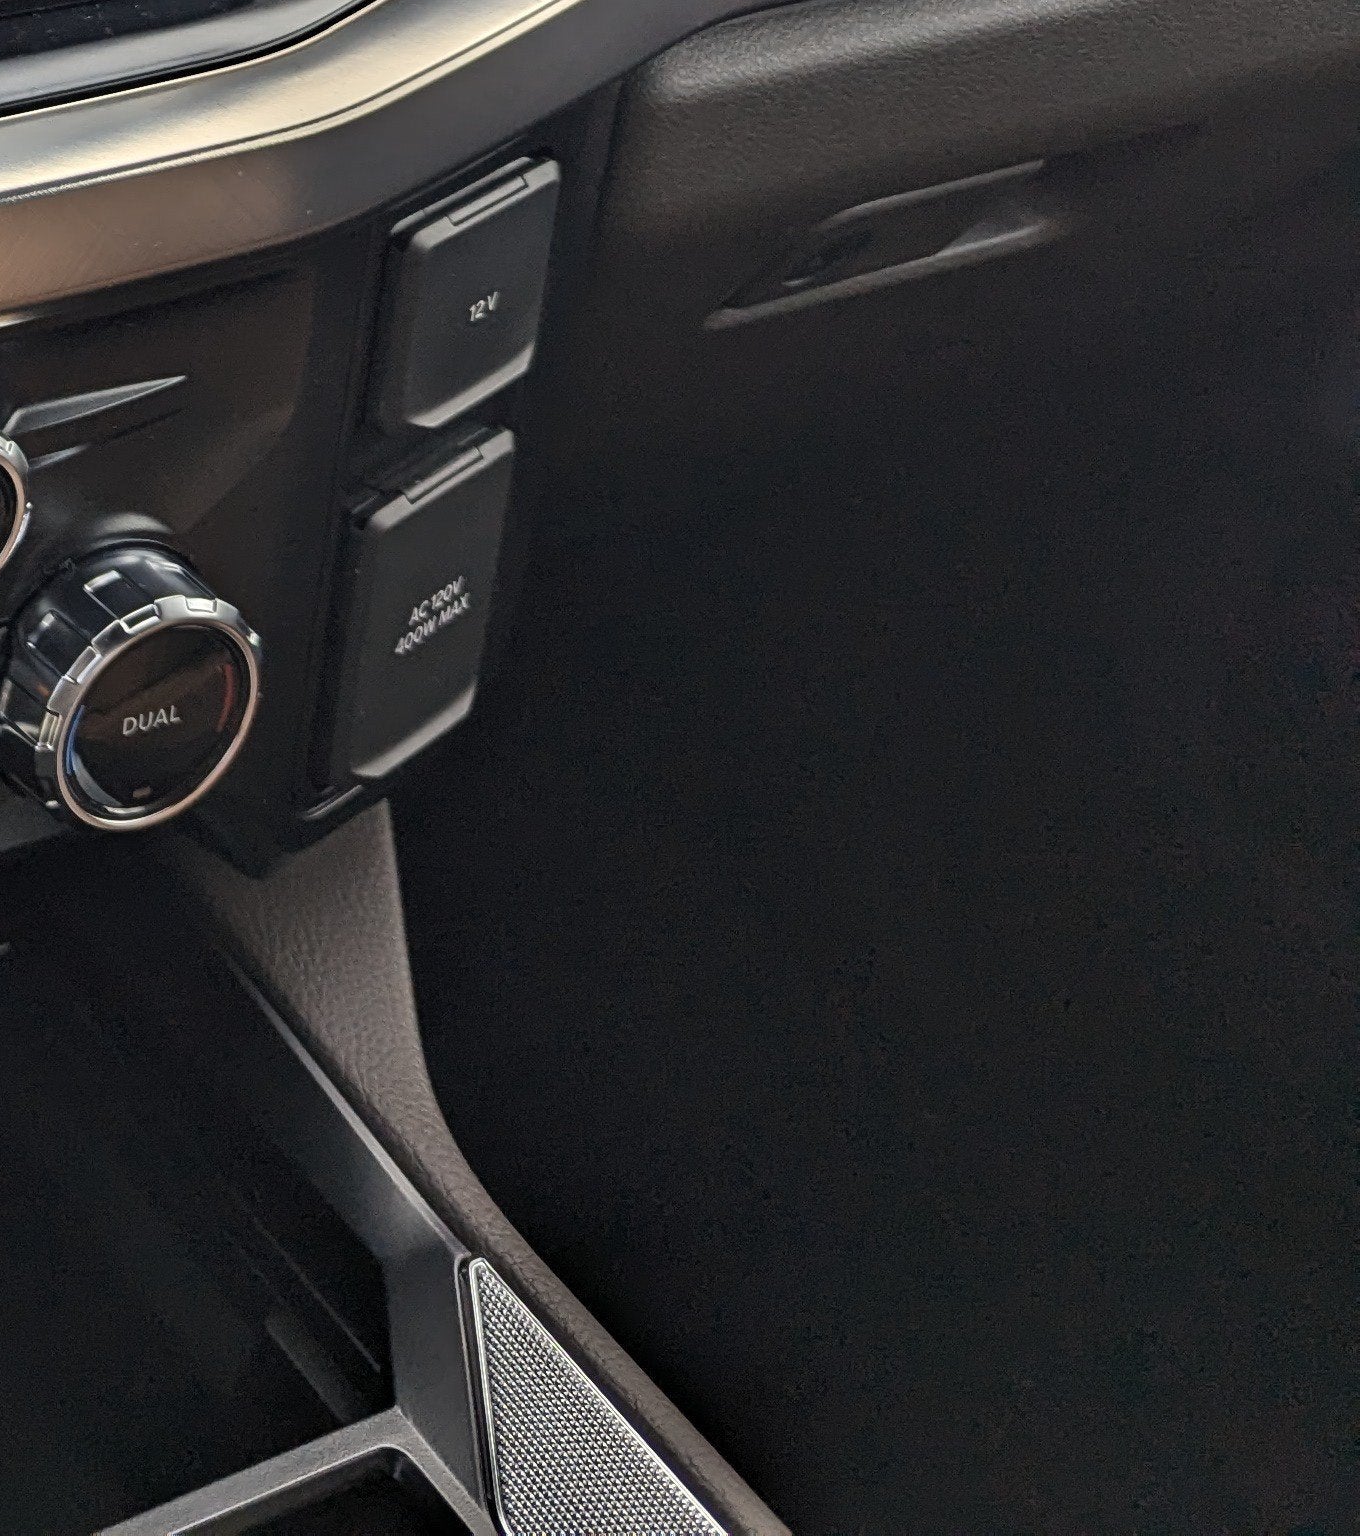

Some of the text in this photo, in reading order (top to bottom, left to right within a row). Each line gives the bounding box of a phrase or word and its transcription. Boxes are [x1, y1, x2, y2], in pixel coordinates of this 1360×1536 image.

[468, 292, 499, 322] 12V
[409, 575, 465, 626] AC 120V
[394, 592, 470, 654] 400W MAX
[121, 705, 181, 736] DUAL
